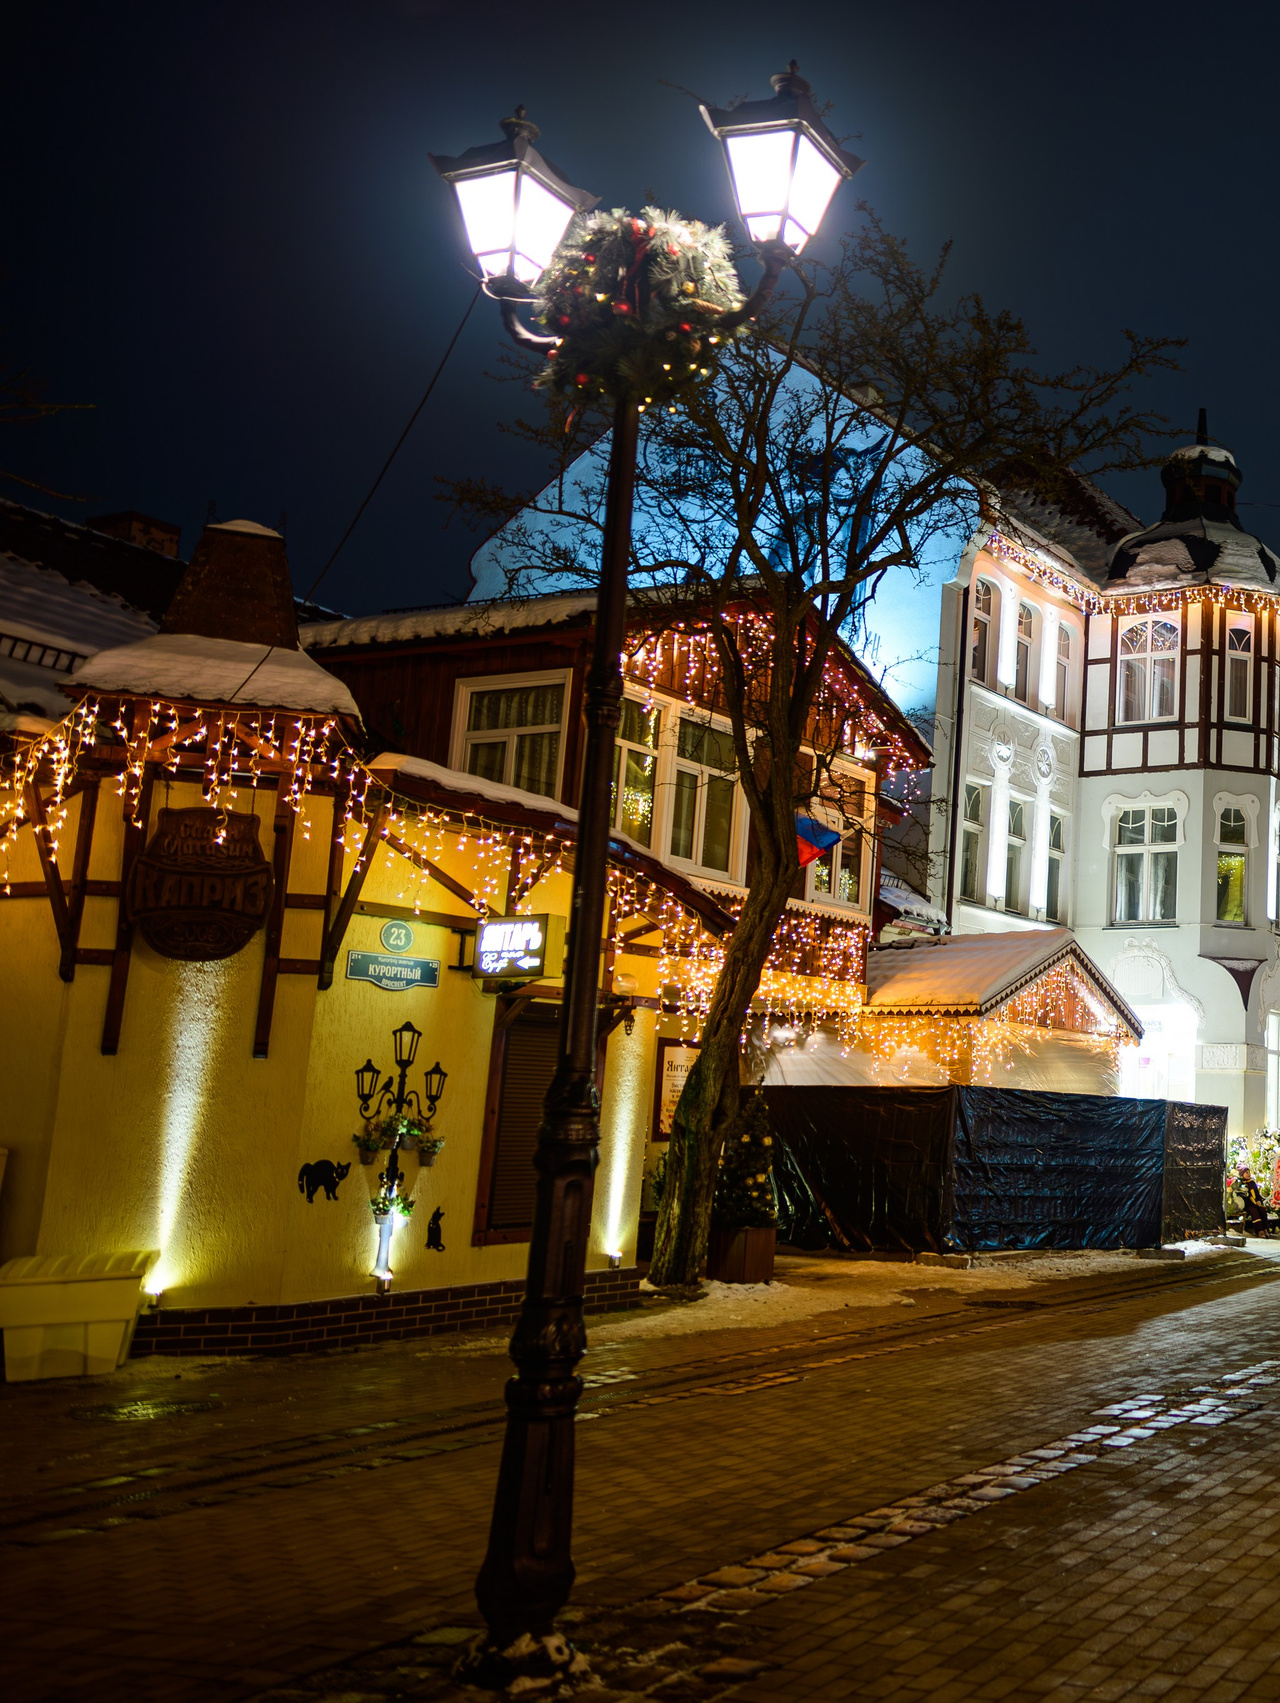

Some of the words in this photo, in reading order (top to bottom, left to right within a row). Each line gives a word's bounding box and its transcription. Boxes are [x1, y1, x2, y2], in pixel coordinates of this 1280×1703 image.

[134, 863, 268, 915] КАПРИЗ
[389, 927, 406, 946] 23
[368, 964, 421, 980] КУРОРТНЫЙ
[381, 978, 407, 988] ПРОСПЕКТ
